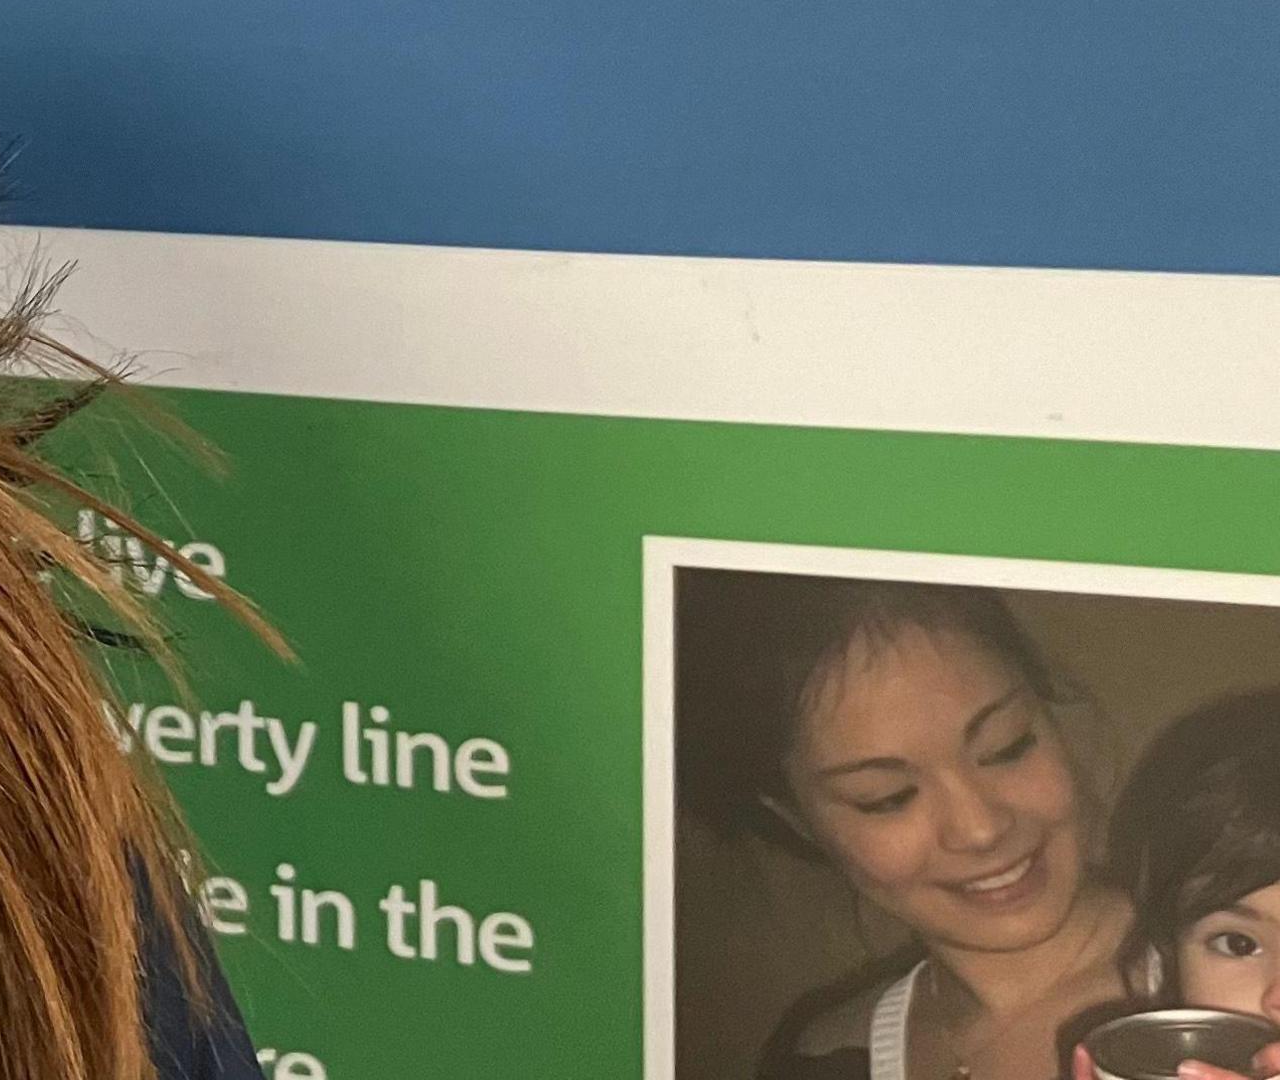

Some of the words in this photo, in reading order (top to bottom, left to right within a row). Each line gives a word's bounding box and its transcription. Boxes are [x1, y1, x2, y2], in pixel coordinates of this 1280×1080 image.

[342, 701, 510, 798] line
[270, 863, 355, 950] in
[379, 878, 534, 973] the
